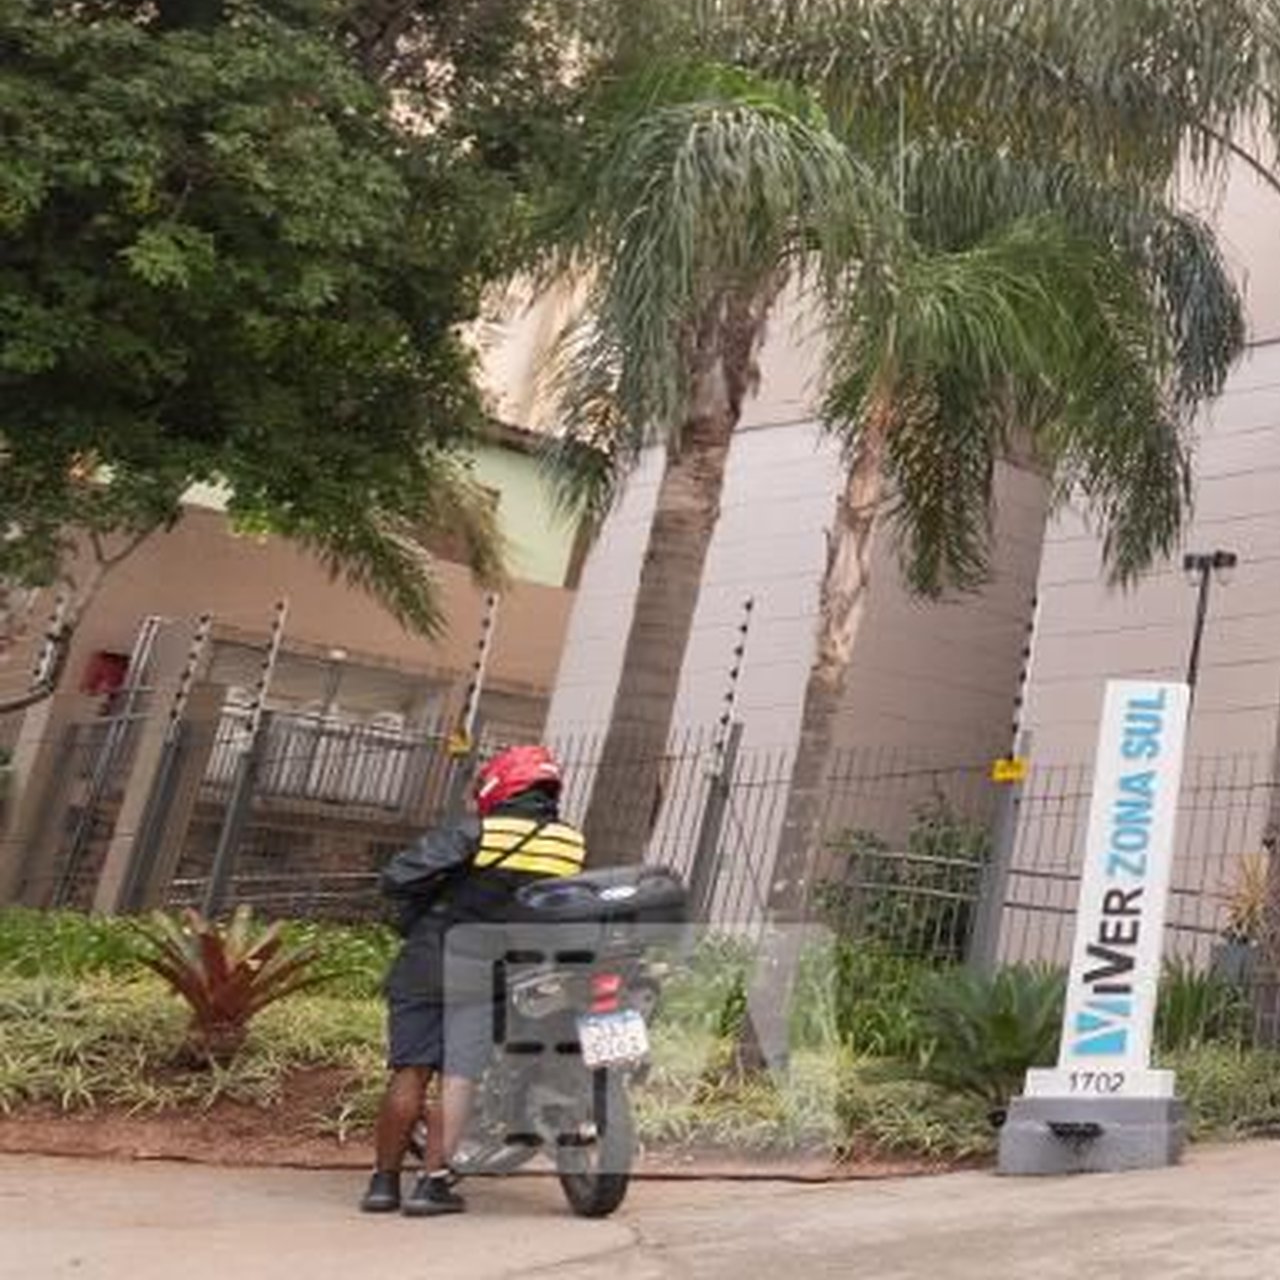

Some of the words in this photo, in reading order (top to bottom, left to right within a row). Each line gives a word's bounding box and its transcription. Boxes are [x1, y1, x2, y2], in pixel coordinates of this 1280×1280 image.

[1120, 687, 1168, 760] SUL
[1104, 769, 1156, 877] ZONA
[1068, 1070, 1126, 1094] 1702
